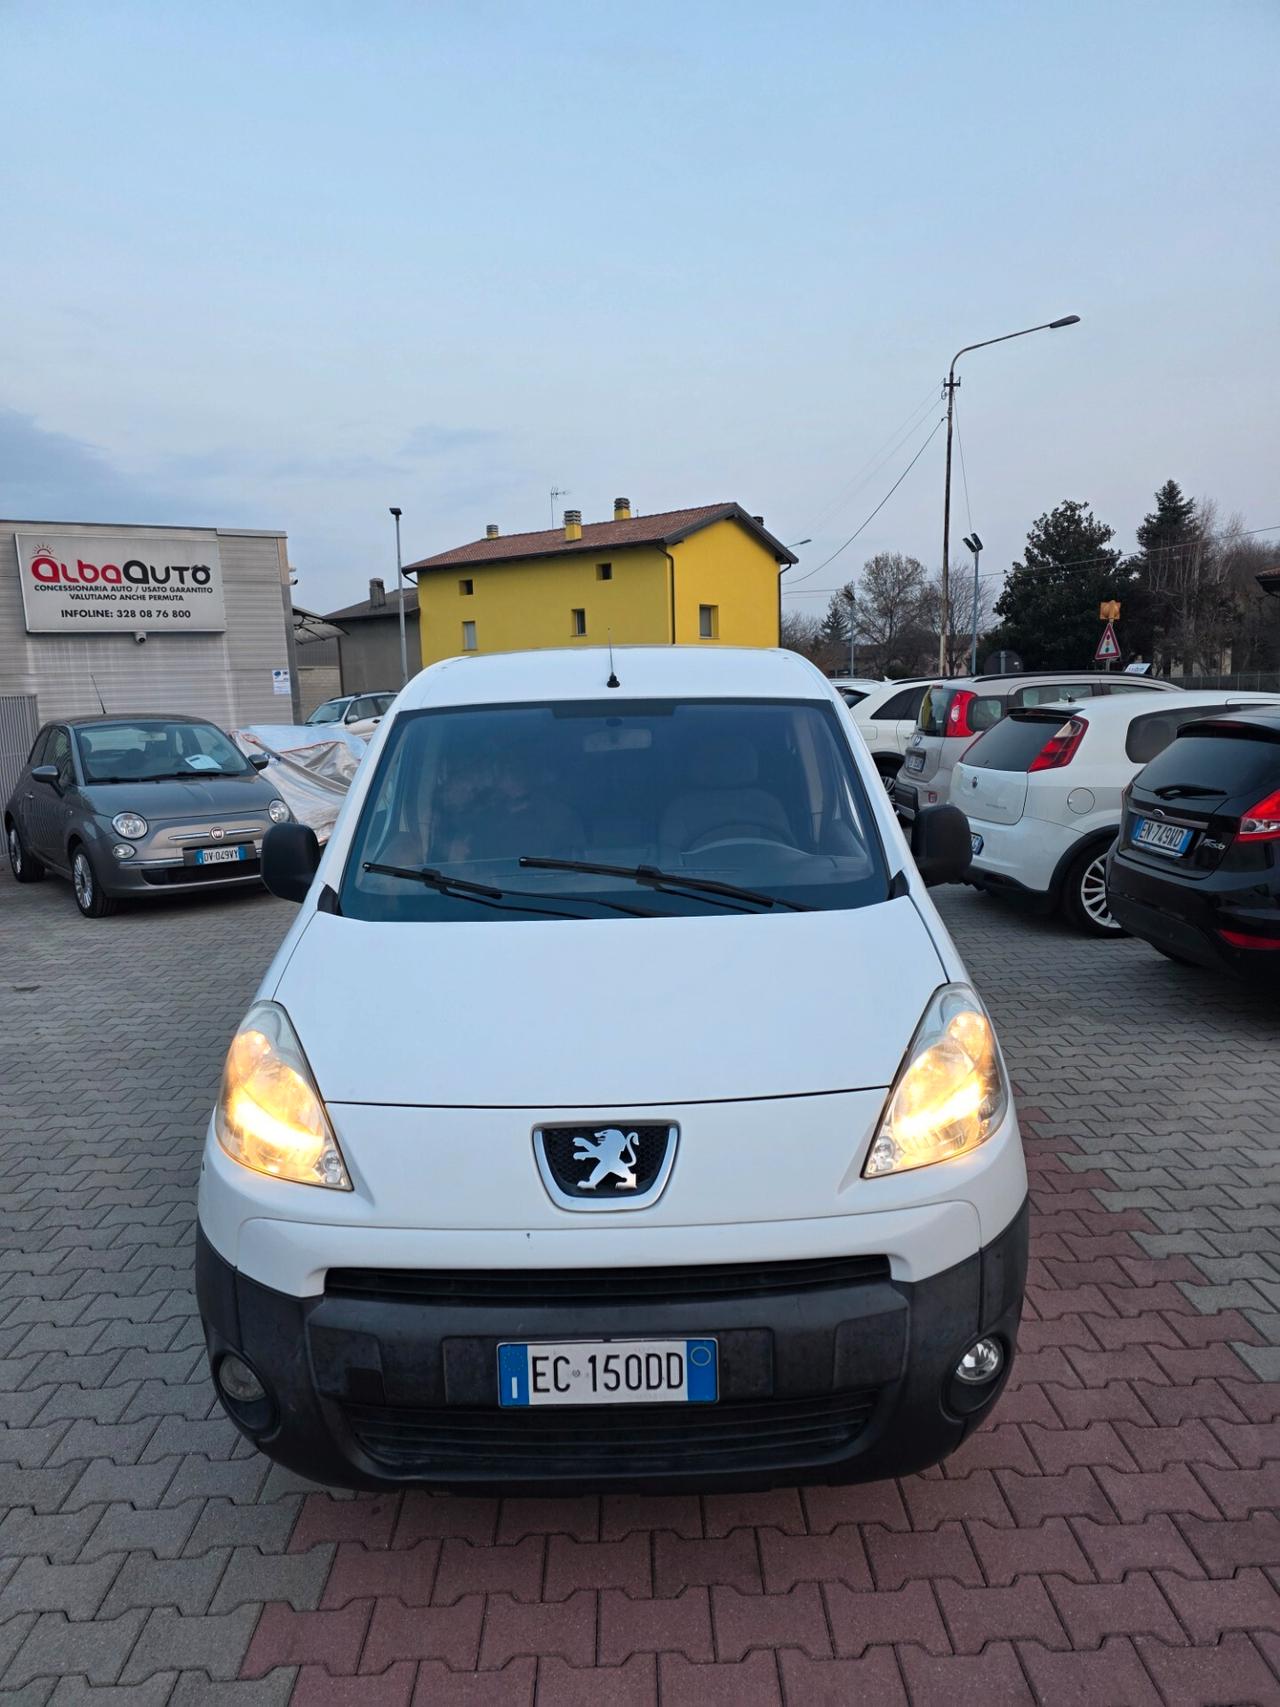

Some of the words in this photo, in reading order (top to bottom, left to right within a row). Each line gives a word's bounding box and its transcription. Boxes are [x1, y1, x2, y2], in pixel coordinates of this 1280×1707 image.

[34, 584, 108, 592] CONCESSIONARIA
[169, 586, 213, 594] GARANTITO
[61, 609, 114, 618] INFOLINE:
[116, 609, 136, 618] 328
[139, 609, 153, 618] 08
[155, 609, 169, 618] 76
[172, 609, 191, 618] 800
[531, 1355, 571, 1393] EC
